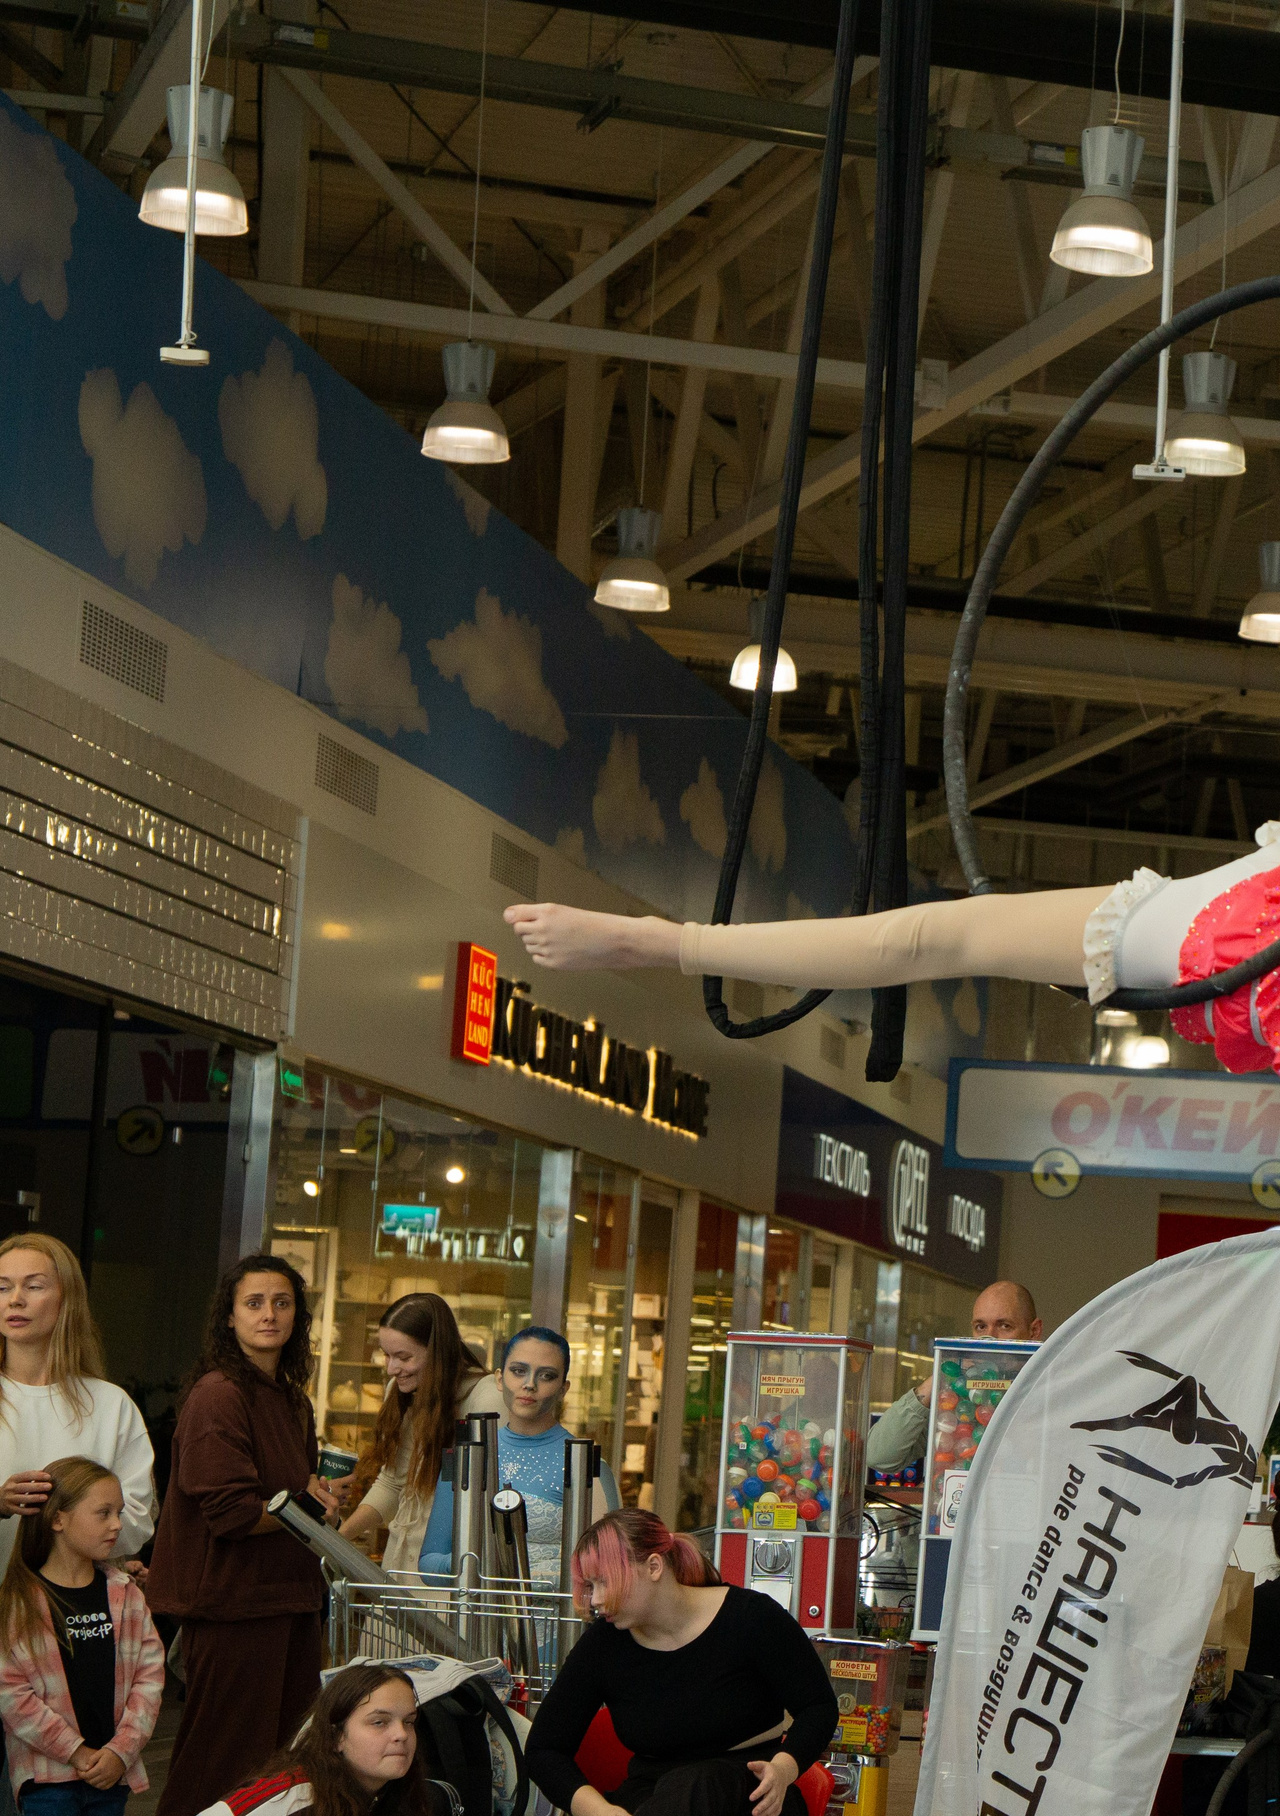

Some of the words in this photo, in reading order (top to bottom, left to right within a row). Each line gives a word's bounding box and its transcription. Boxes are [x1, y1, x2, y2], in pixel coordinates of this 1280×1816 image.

[472, 961, 492, 990] KÜC
[470, 991, 491, 1017] HEN
[468, 1021, 488, 1047] LAND
[816, 1132, 870, 1197] ТЕКСТИЛЬ
[951, 1195, 985, 1252] ПОСУДА
[972, 1381, 1005, 1389] ИГРУШКА
[1053, 1463, 1086, 1521] pole
[1021, 1525, 1062, 1601] dance
[1011, 1604, 1033, 1625] &
[979, 1485, 1142, 1816] НАШЕСТ
[831, 1670, 861, 1678] НЕСКОЛЬКО
[862, 1672, 877, 1680] ШТУК
[835, 1661, 871, 1670] КОНФЕТЫ
[976, 1628, 1021, 1774] воздушн
